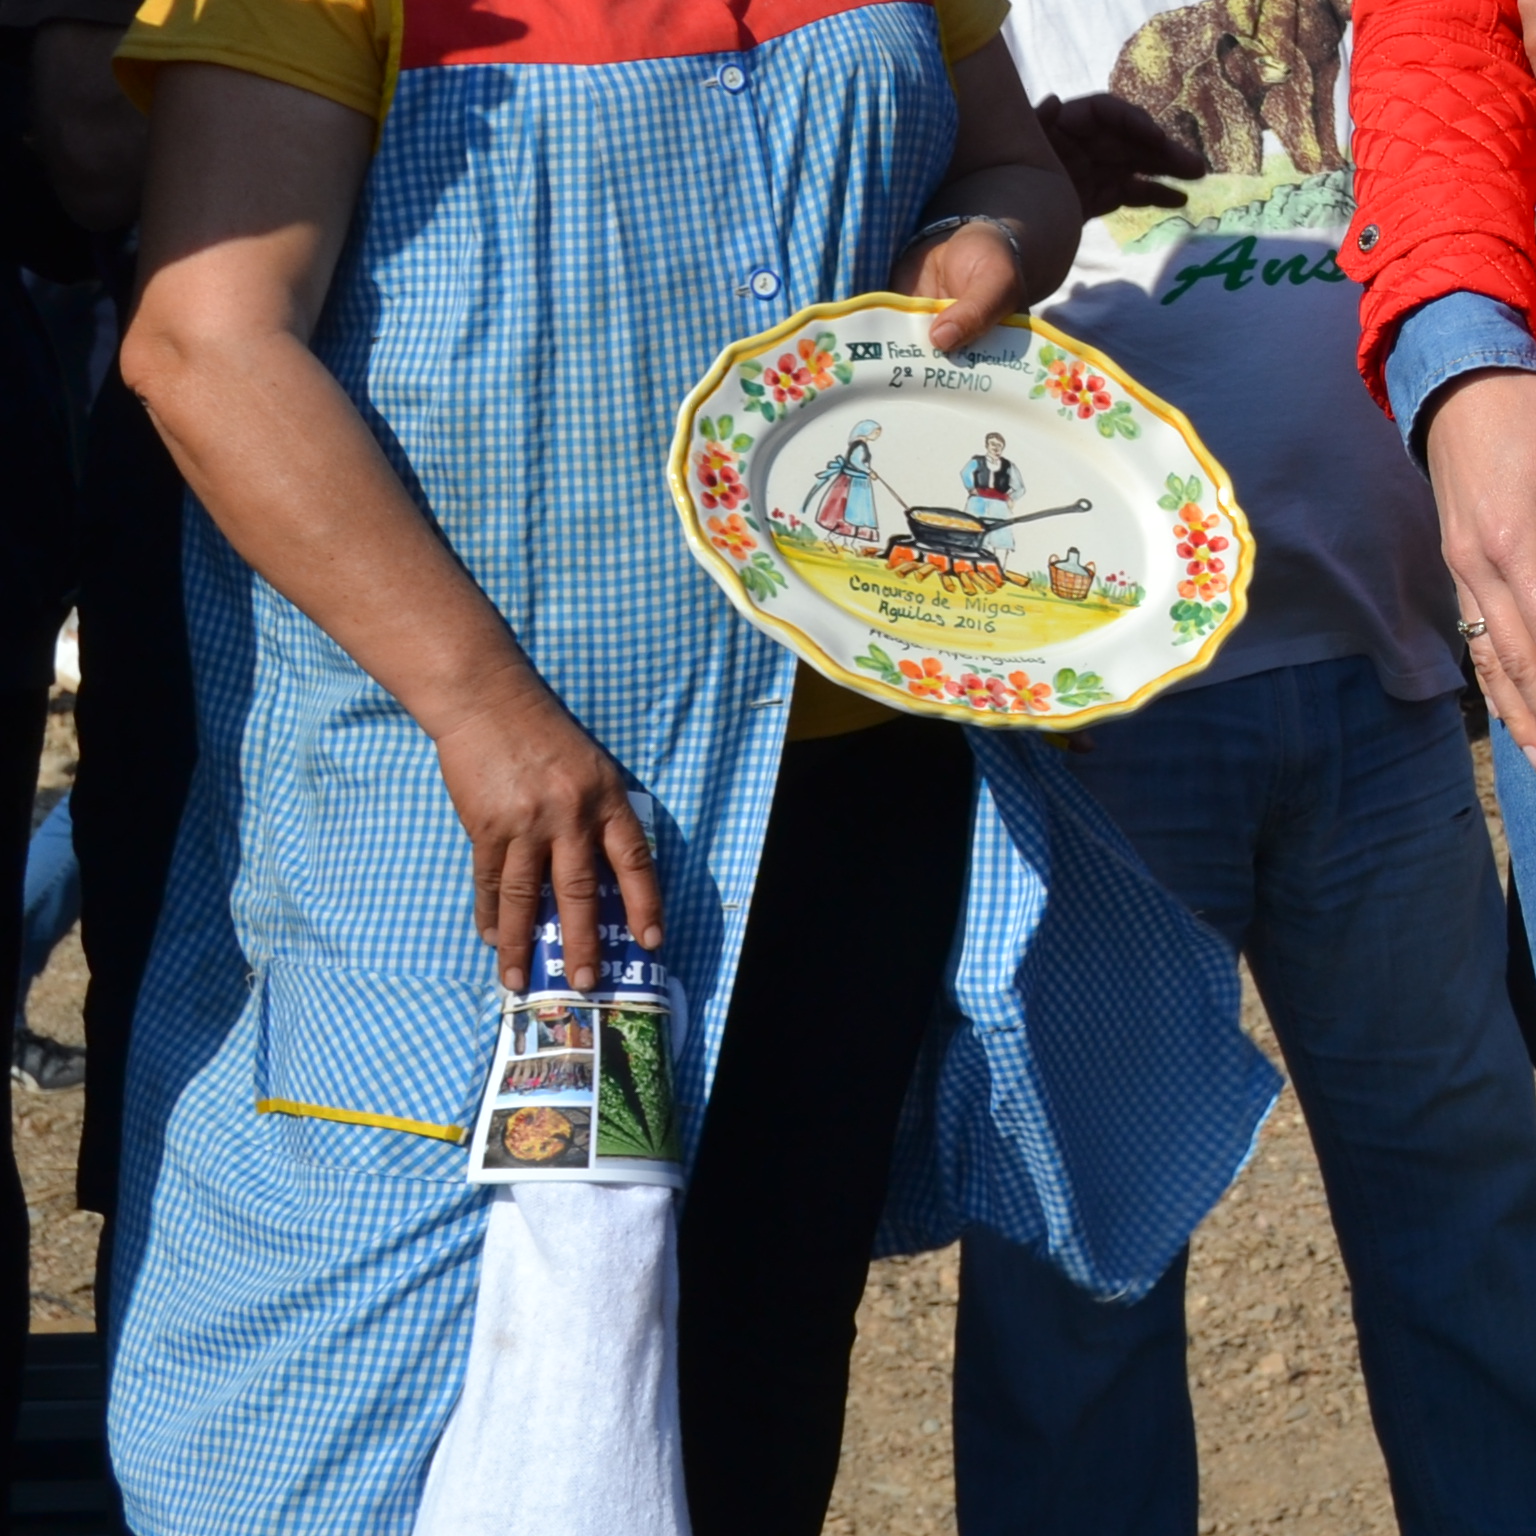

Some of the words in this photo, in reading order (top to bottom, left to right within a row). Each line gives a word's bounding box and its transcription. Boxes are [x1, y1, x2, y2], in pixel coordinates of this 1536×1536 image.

[1160, 235, 1346, 306] Ans
[887, 341, 925, 359] Fiesta
[957, 347, 1035, 375] Agricultor
[923, 367, 993, 393] PREMIO
[849, 574, 926, 605] Concurso
[931, 590, 951, 610] de
[965, 597, 1026, 619] Migas
[878, 600, 946, 627] Aguilas
[954, 615, 996, 633] 2016
